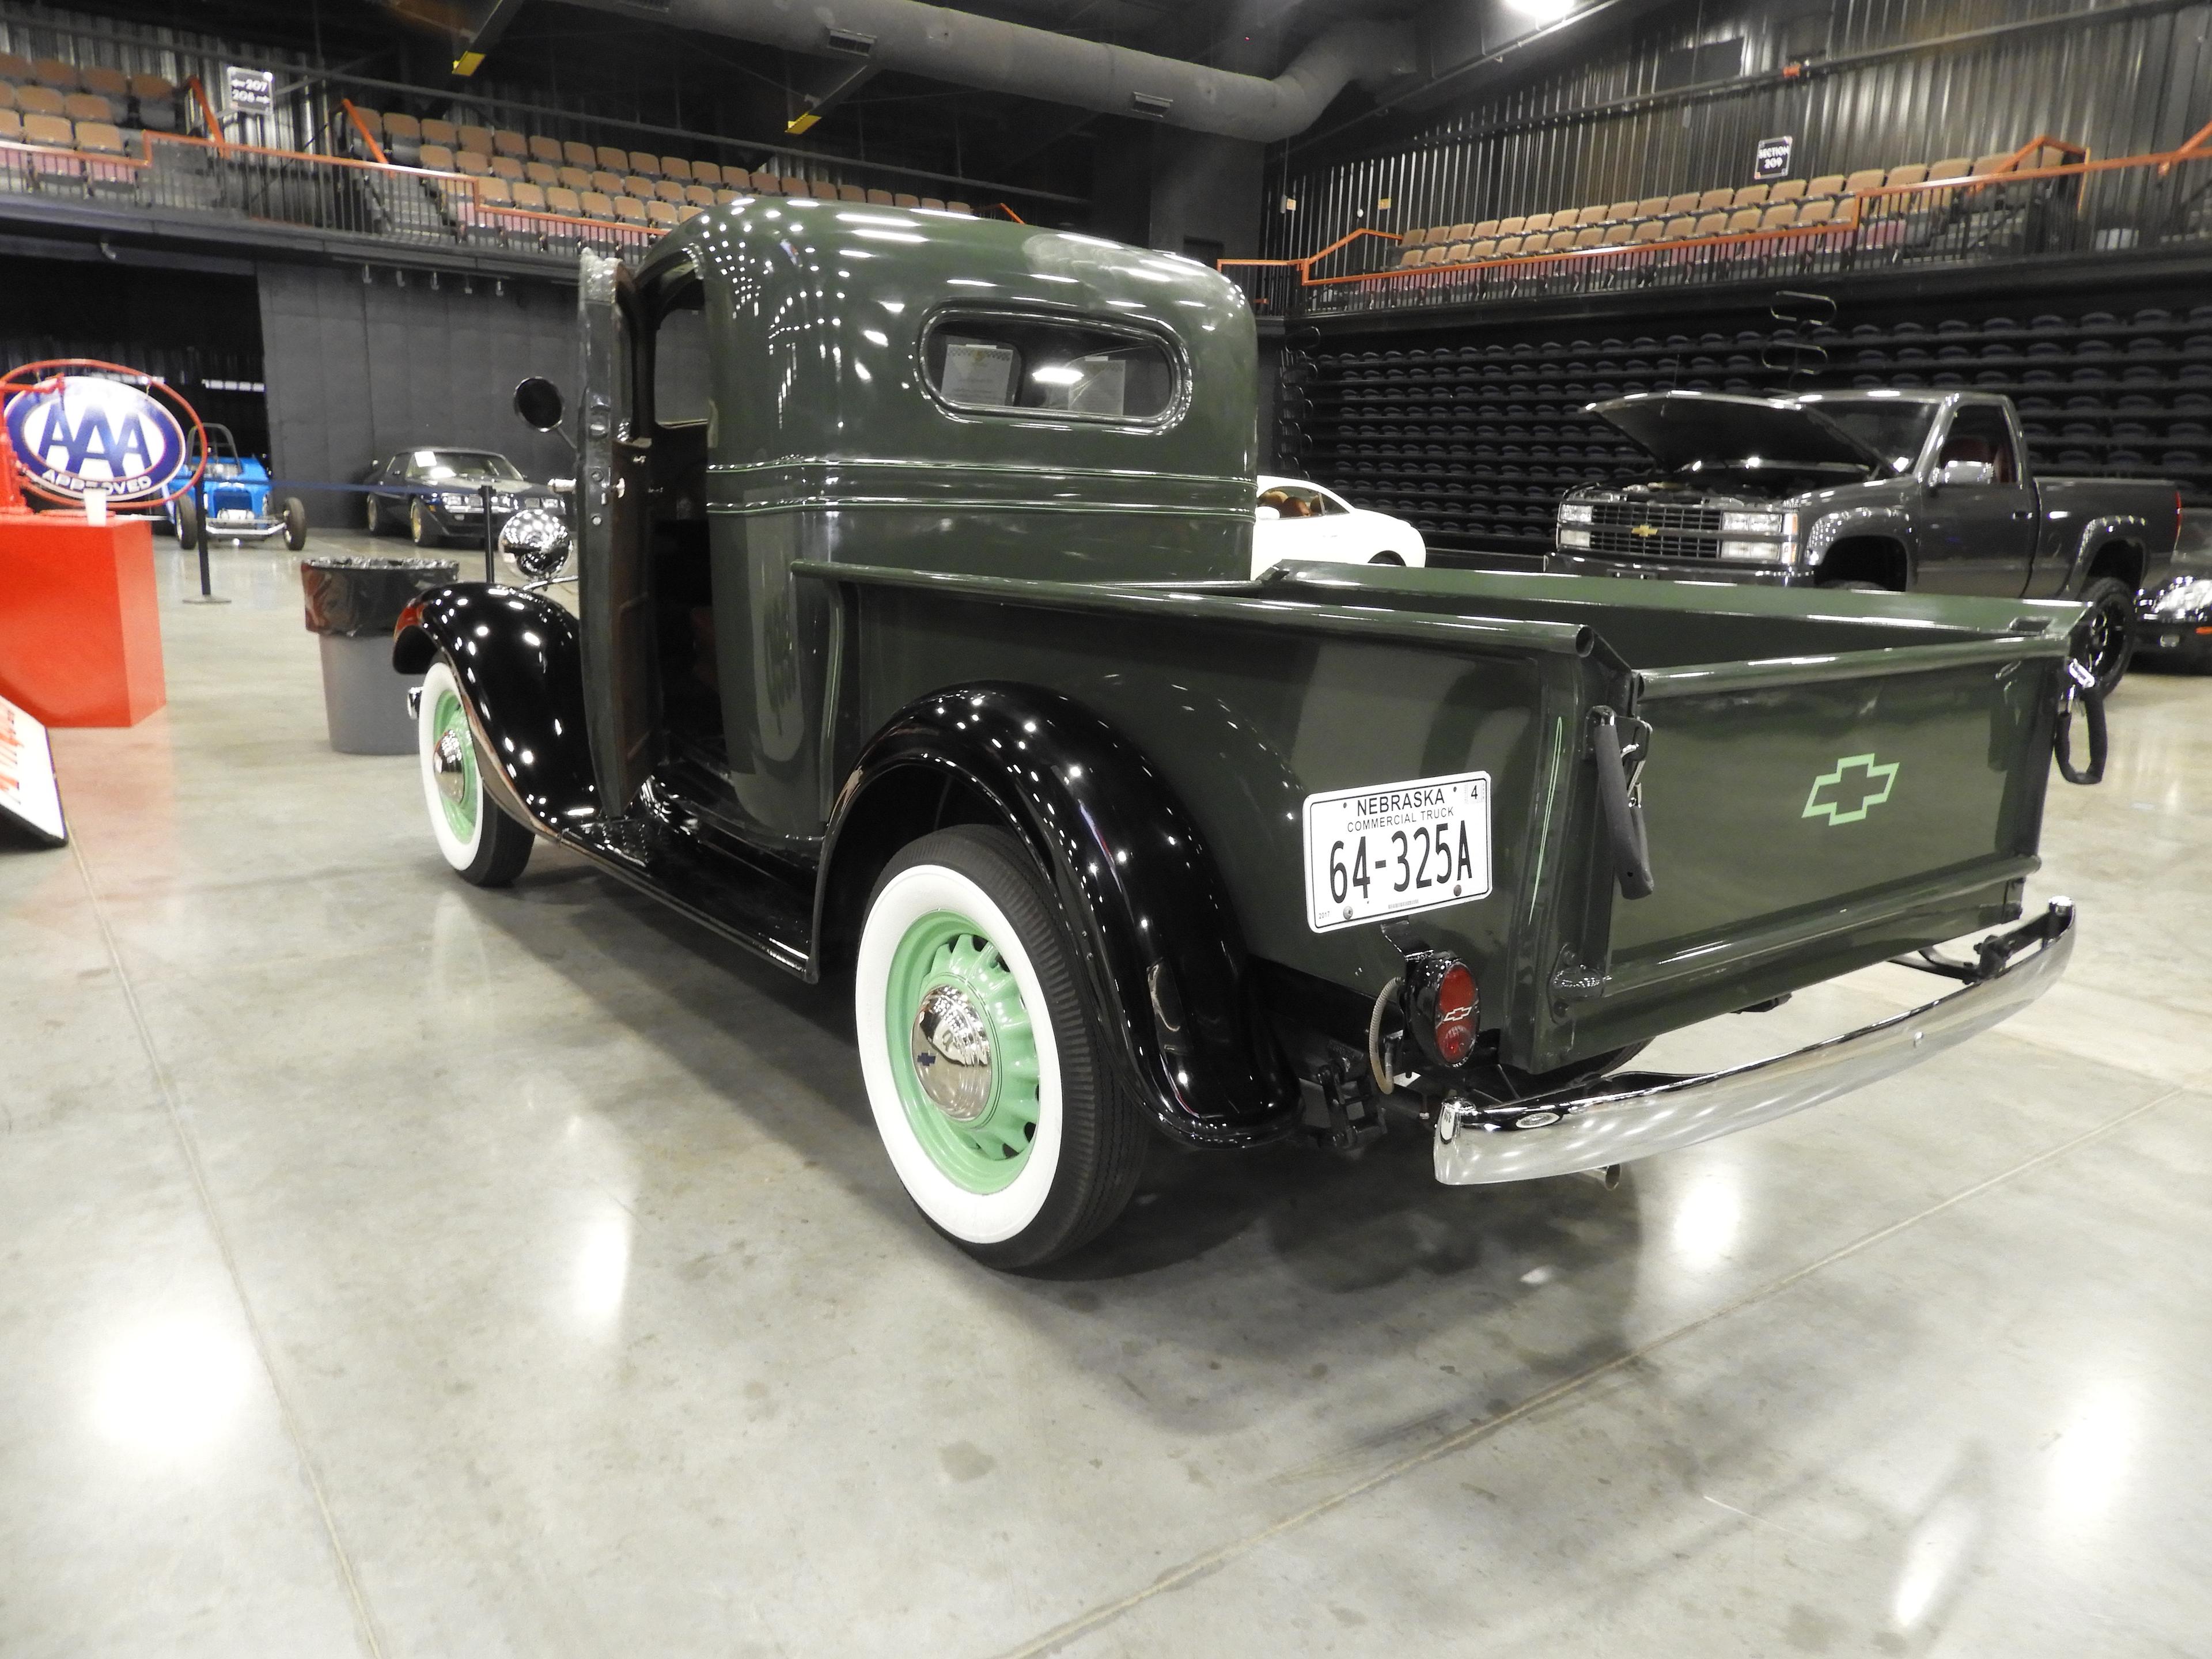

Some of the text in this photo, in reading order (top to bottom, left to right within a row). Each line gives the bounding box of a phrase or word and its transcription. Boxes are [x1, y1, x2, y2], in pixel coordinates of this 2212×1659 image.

[245, 79, 267, 92] 207
[1758, 145, 1789, 159] SECTION
[1764, 157, 1783, 169] 209
[37, 401, 152, 478] AAA
[1471, 785, 1478, 800] 4
[1357, 787, 1445, 817] NEBRASKA
[1347, 806, 1454, 832] COMMERCIAL TRUCK
[1330, 820, 1472, 904] 64-325A
[1318, 911, 1330, 919] 2017
